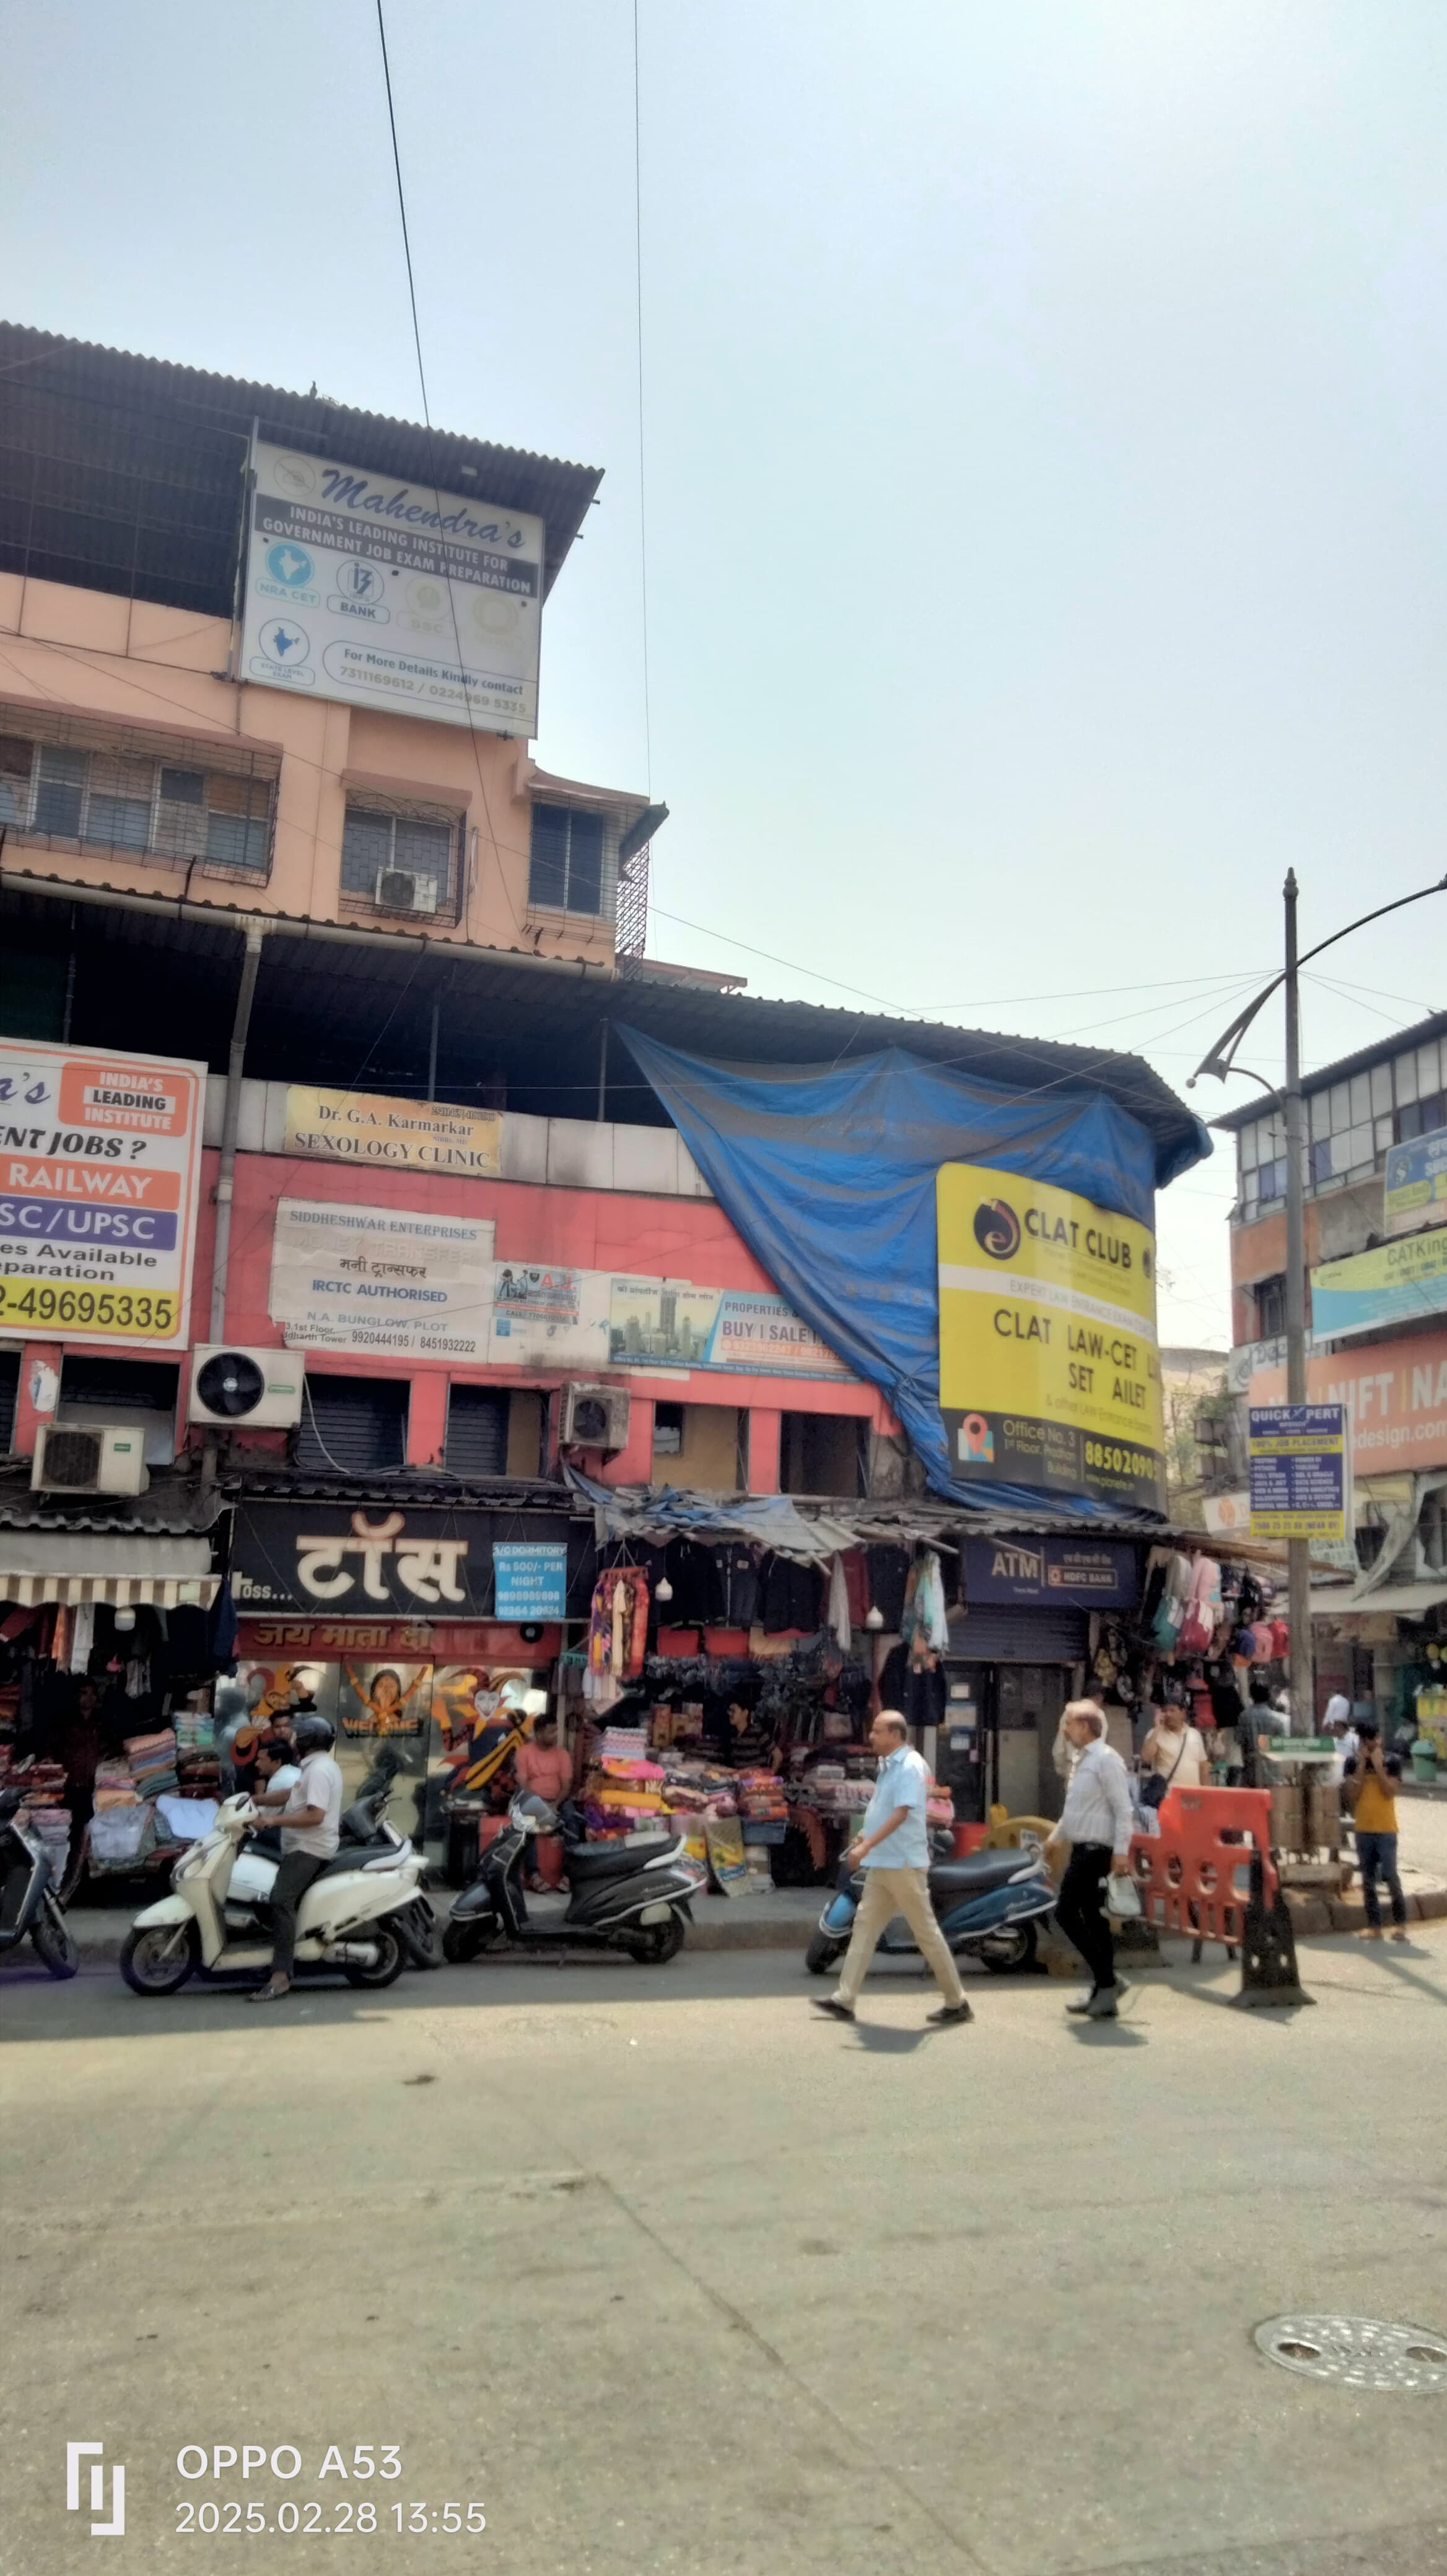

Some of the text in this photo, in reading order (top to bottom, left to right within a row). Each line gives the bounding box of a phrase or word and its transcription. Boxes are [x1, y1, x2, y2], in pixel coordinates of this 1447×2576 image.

[321, 469, 526, 548] Mahendra's
[290, 506, 508, 572] INDIA'S LEADING INSTITUTE FOR
[263, 517, 531, 593] GOVERNMENT JOB EXAM PREPARATION
[260, 583, 317, 604] NRA CET
[340, 601, 376, 619] BANK
[260, 663, 305, 677] STATE LEVEL
[344, 648, 523, 695] For More Details Kindly contact
[99, 1071, 164, 1092] INDIA'S
[92, 1089, 167, 1111] LEADING
[84, 1107, 172, 1130] INSTITUTE
[318, 1105, 342, 1122] Dr.
[347, 1108, 382, 1126] G.A.
[387, 1113, 474, 1137] Karmarkar
[294, 1132, 491, 1168] SEXOLOGY CLINIC
[9, 1162, 153, 1199] RAILWAY
[289, 1209, 477, 1240] SIDDHESHWAR ENTERPRISES
[1025, 1208, 1132, 1269] CLAT CLUB
[37, 1243, 158, 1268] Available
[339, 1256, 367, 1273] मनी
[0, 1260, 115, 1281] paration
[312, 1279, 448, 1302] IRCTC AUTHORISED
[1010, 1279, 1046, 1297] EXPERT
[1049, 1289, 1068, 1303] LAW
[1071, 1295, 1112, 1319] ENTRANCE
[725, 1301, 789, 1318] PROPERTIES
[414, 1321, 448, 1333] PLOT
[722, 1320, 754, 1338] BUY
[769, 1325, 807, 1342] SALE
[321, 1335, 347, 1343] Tower
[352, 1331, 409, 1347] 9920444195
[420, 1336, 476, 1352] 8451932222
[994, 1308, 1051, 1344] CLAT
[1067, 1324, 1137, 1371] LAW-CET
[1069, 1362, 1146, 1411] SET AILET
[1055, 1397, 1078, 1412] other
[1003, 1419, 1076, 1447] Office No. 3
[296, 1511, 468, 1603] टॉस
[512, 1546, 565, 1555] DORMITORY
[544, 1562, 562, 1571] PER
[992, 1551, 1039, 1578] ATM
[511, 1576, 544, 1586] NIGHT
[254, 1623, 315, 1646] जय
[321, 1624, 391, 1648] माता
